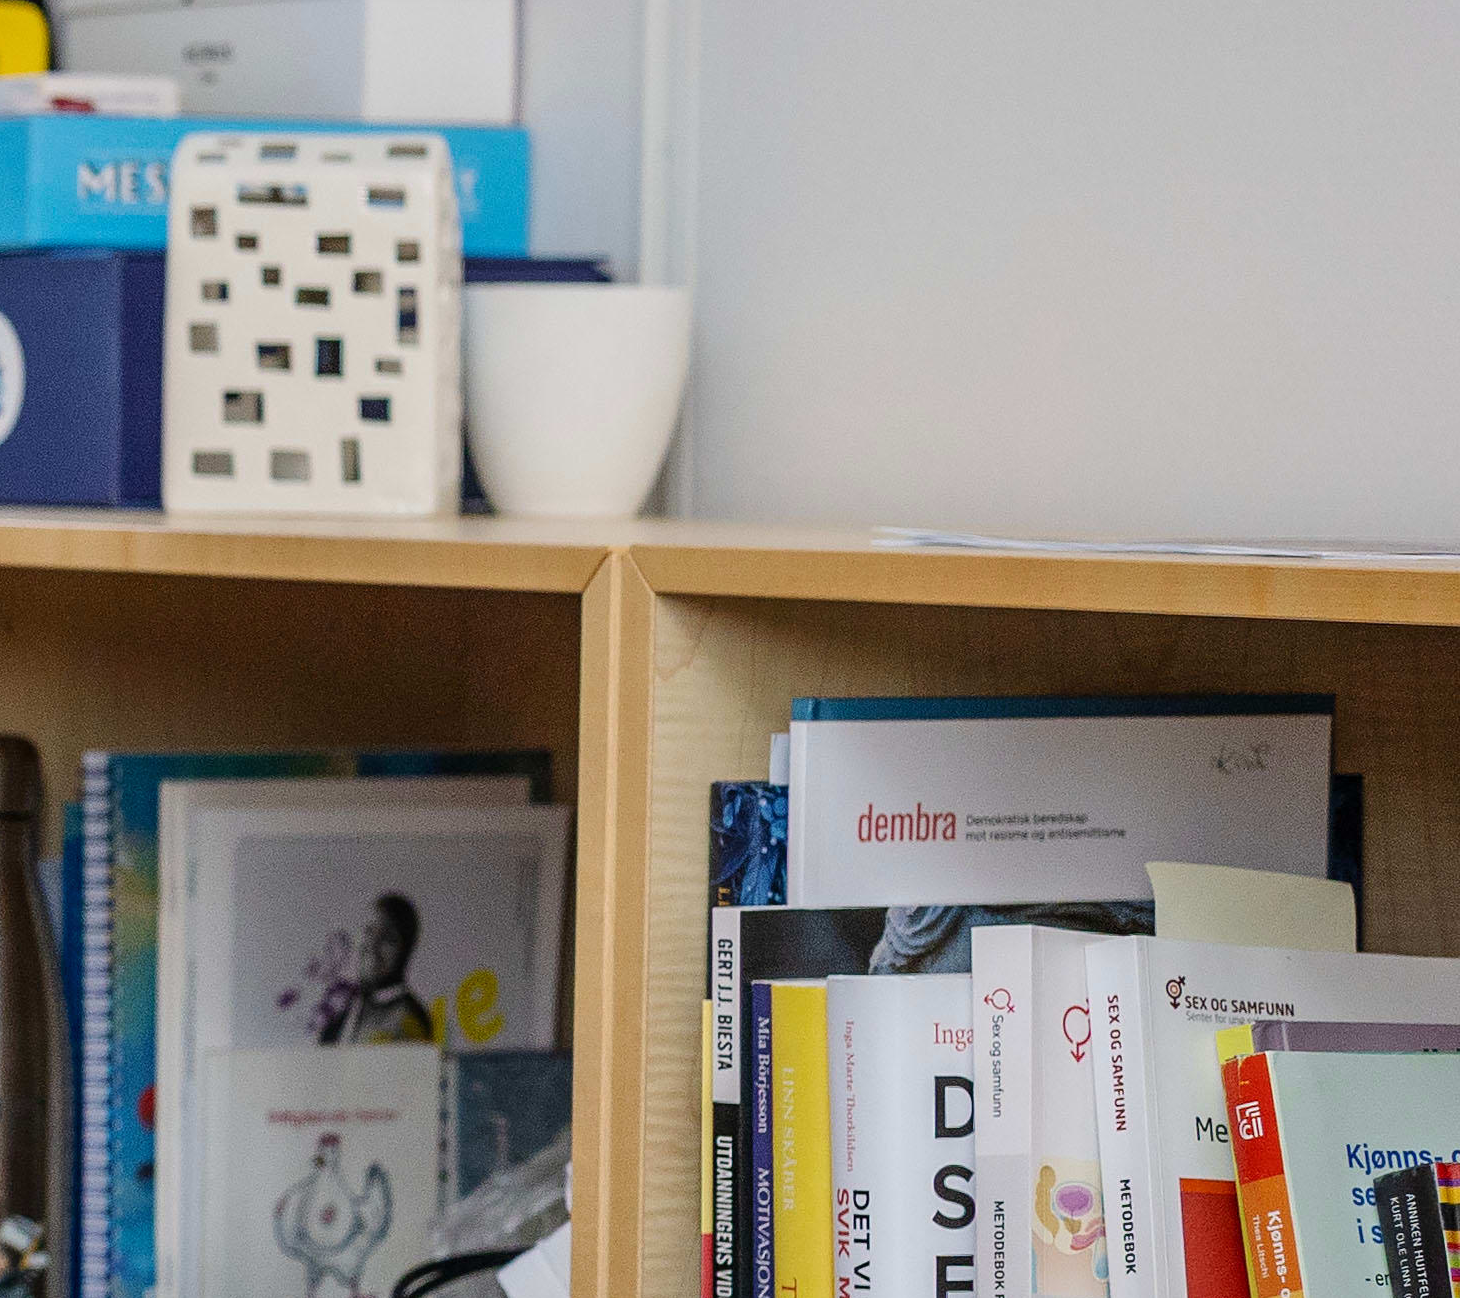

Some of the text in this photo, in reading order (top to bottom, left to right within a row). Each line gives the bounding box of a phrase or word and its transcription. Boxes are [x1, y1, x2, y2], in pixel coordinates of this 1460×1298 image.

[857, 803, 957, 843] dembra
[966, 812, 1089, 827] Demokratisk beredskap
[966, 829, 986, 842] mot
[1031, 830, 1046, 843] og
[717, 938, 734, 1071] GERT J.J. BIESTA
[1184, 995, 1296, 1018] SEX OG SAMFUNN
[844, 1019, 855, 1049] Inga
[755, 1016, 771, 1134] Mia Börjesson
[989, 1014, 1004, 1119] Sex og samfunn
[1107, 994, 1127, 1133] SEX OG SAMFUNN
[1194, 1116, 1229, 1144] Me
[1346, 1142, 1443, 1176] Kjønns-
[716, 1136, 734, 1266] UTDANNINGENS
[1389, 1196, 1404, 1229] KURT
[837, 1188, 850, 1258] SVIK
[853, 1190, 870, 1251] DET
[1119, 1178, 1137, 1275] METODEBOK
[1252, 1214, 1263, 1243] Thea
[1356, 1217, 1365, 1245] i
[1405, 1193, 1423, 1247] ANNIKEN
[993, 1200, 1005, 1290] METODEBOK
[1267, 1209, 1288, 1284] Kjønns-
[1395, 1232, 1408, 1256] OLE
[854, 1260, 871, 1291] VI
[1399, 1258, 1412, 1288] LINN
